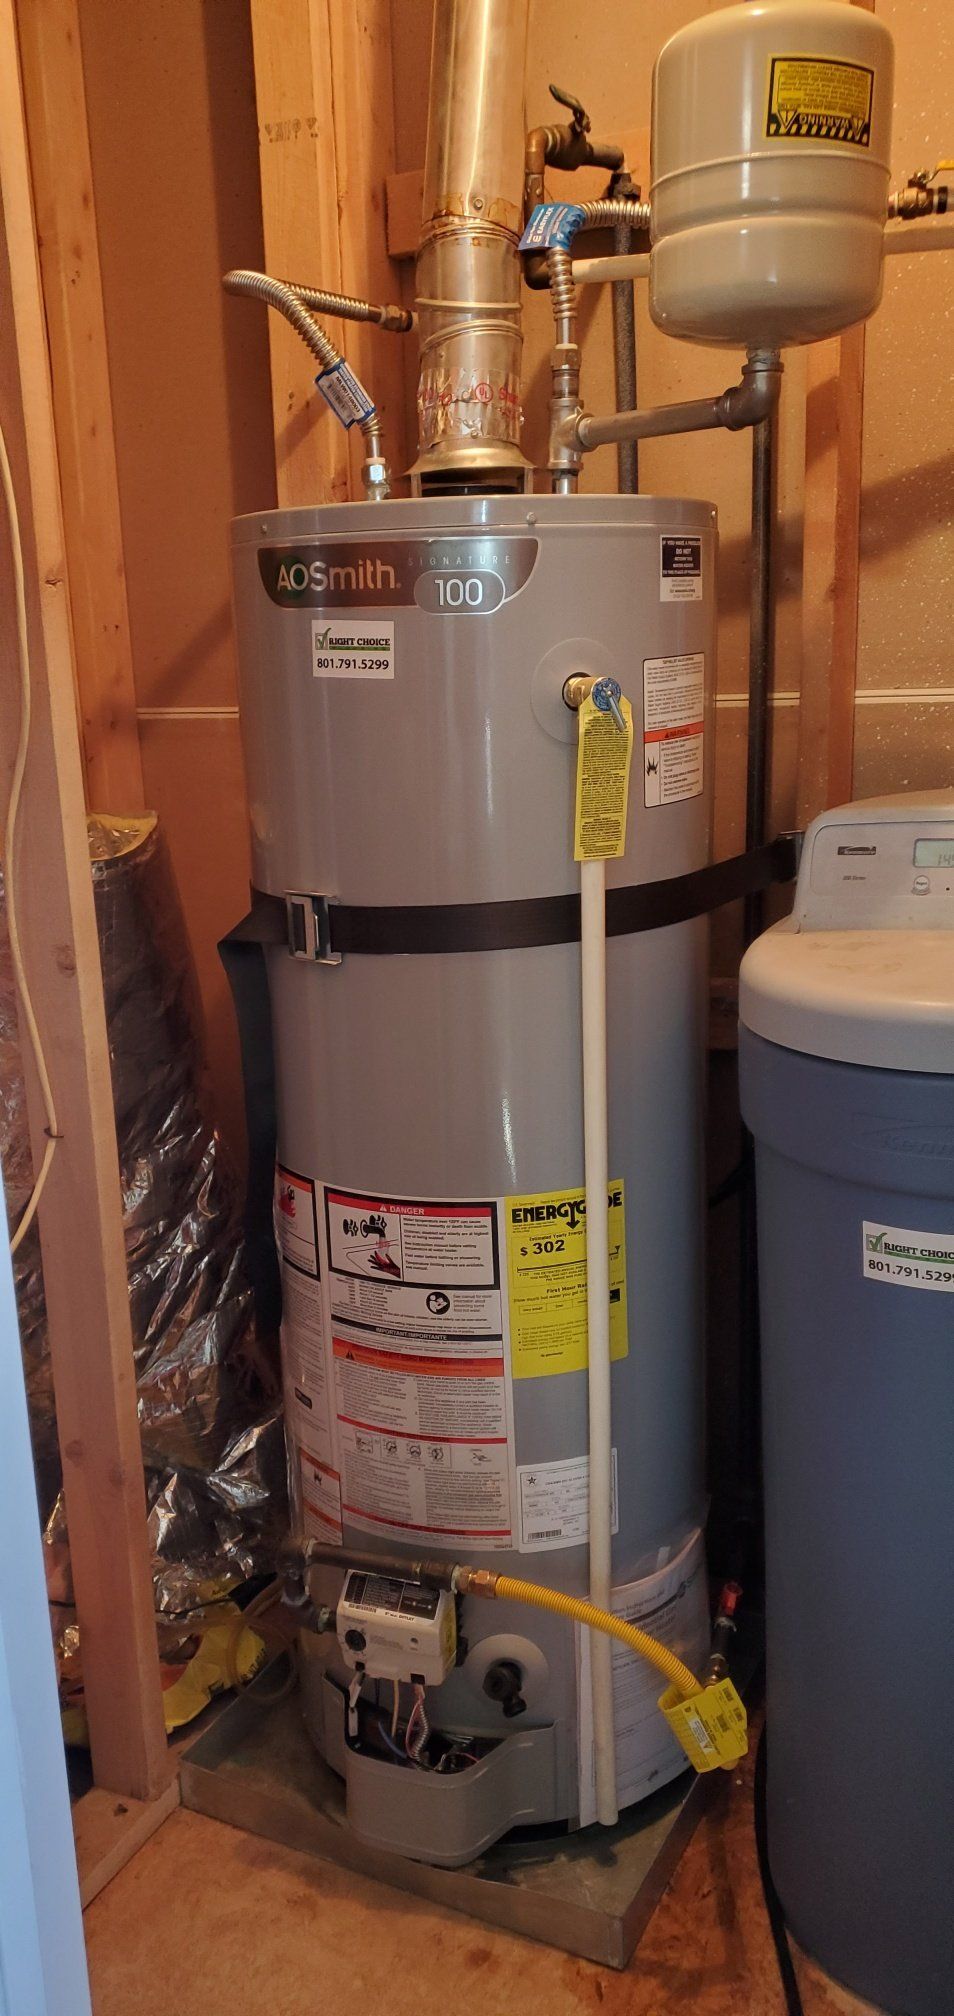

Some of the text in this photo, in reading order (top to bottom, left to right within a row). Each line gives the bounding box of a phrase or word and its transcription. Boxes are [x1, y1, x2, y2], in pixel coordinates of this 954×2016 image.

[799, 114, 849, 128] WARNING
[408, 554, 512, 567] SIGNATURE
[434, 578, 484, 607] 100
[329, 637, 391, 647] RIGHT CHOICE
[316, 657, 390, 671] 801.791.5299
[390, 1205, 424, 1216] DANGER
[520, 1240, 566, 1256] $ 302
[884, 1241, 918, 1256] RIGHT
